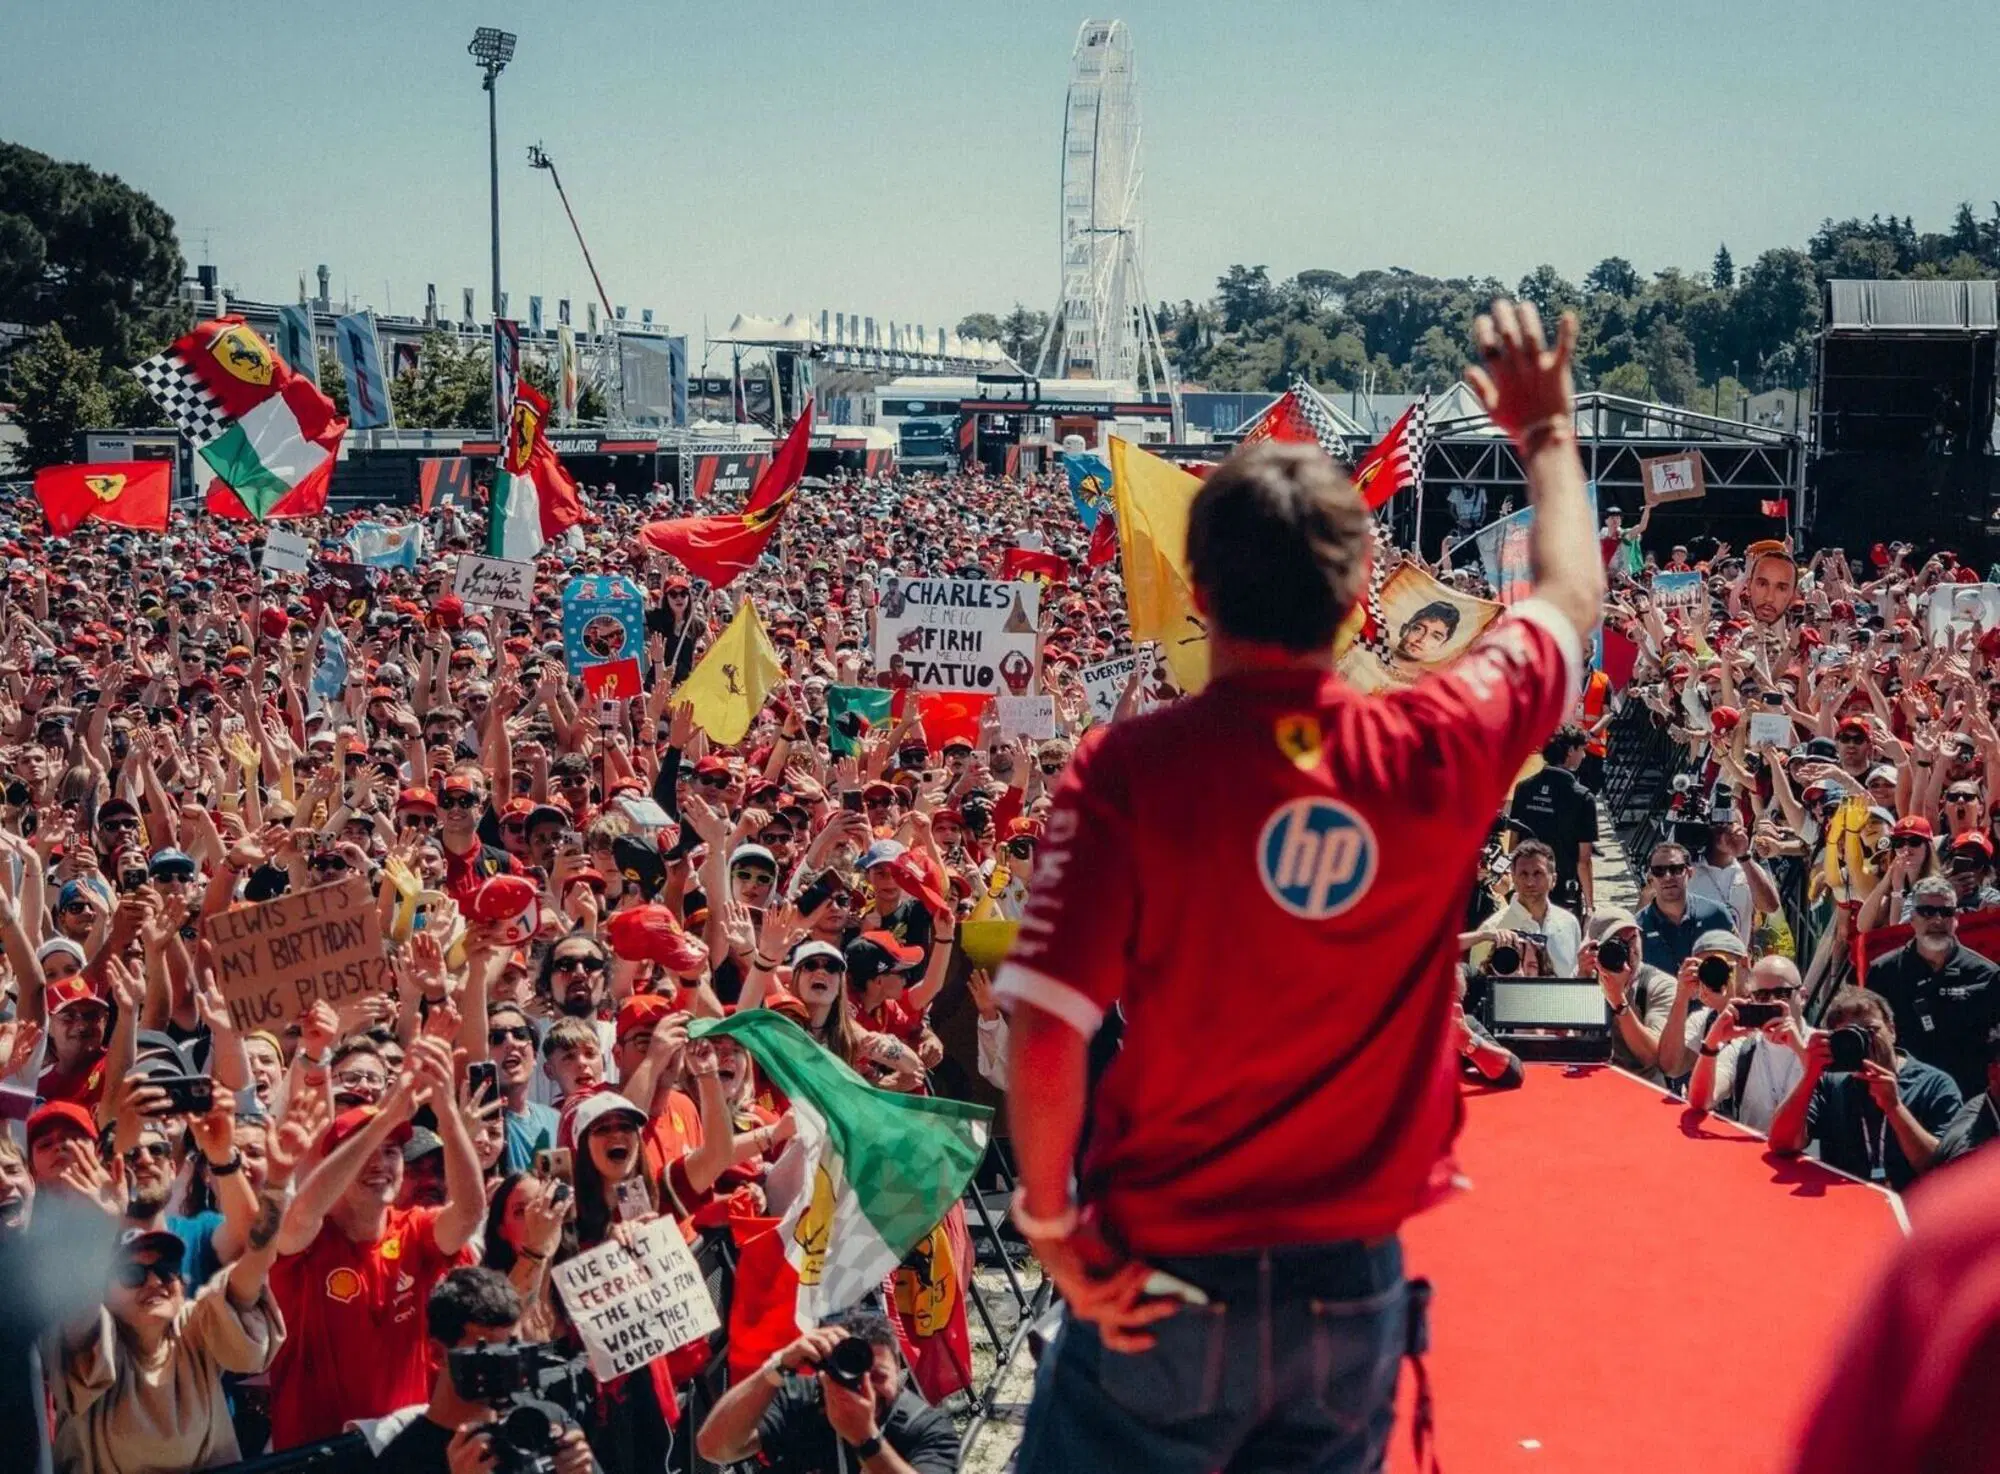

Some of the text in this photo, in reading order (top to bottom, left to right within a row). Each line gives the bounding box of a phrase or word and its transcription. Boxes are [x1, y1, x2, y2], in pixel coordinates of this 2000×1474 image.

[905, 582, 1011, 608] CHARLES
[924, 628, 982, 652] FIRMI
[905, 661, 994, 687] TATUO
[1084, 656, 1137, 684] EVERYBO
[1274, 803, 1362, 912] hp
[209, 901, 286, 945] LEWIS
[220, 914, 366, 983] MY BIRTHDAY
[230, 988, 283, 1032] HUG
[590, 1301, 631, 1330] THE
[633, 1283, 671, 1314] KIDS
[613, 1338, 665, 1374] LOVED
